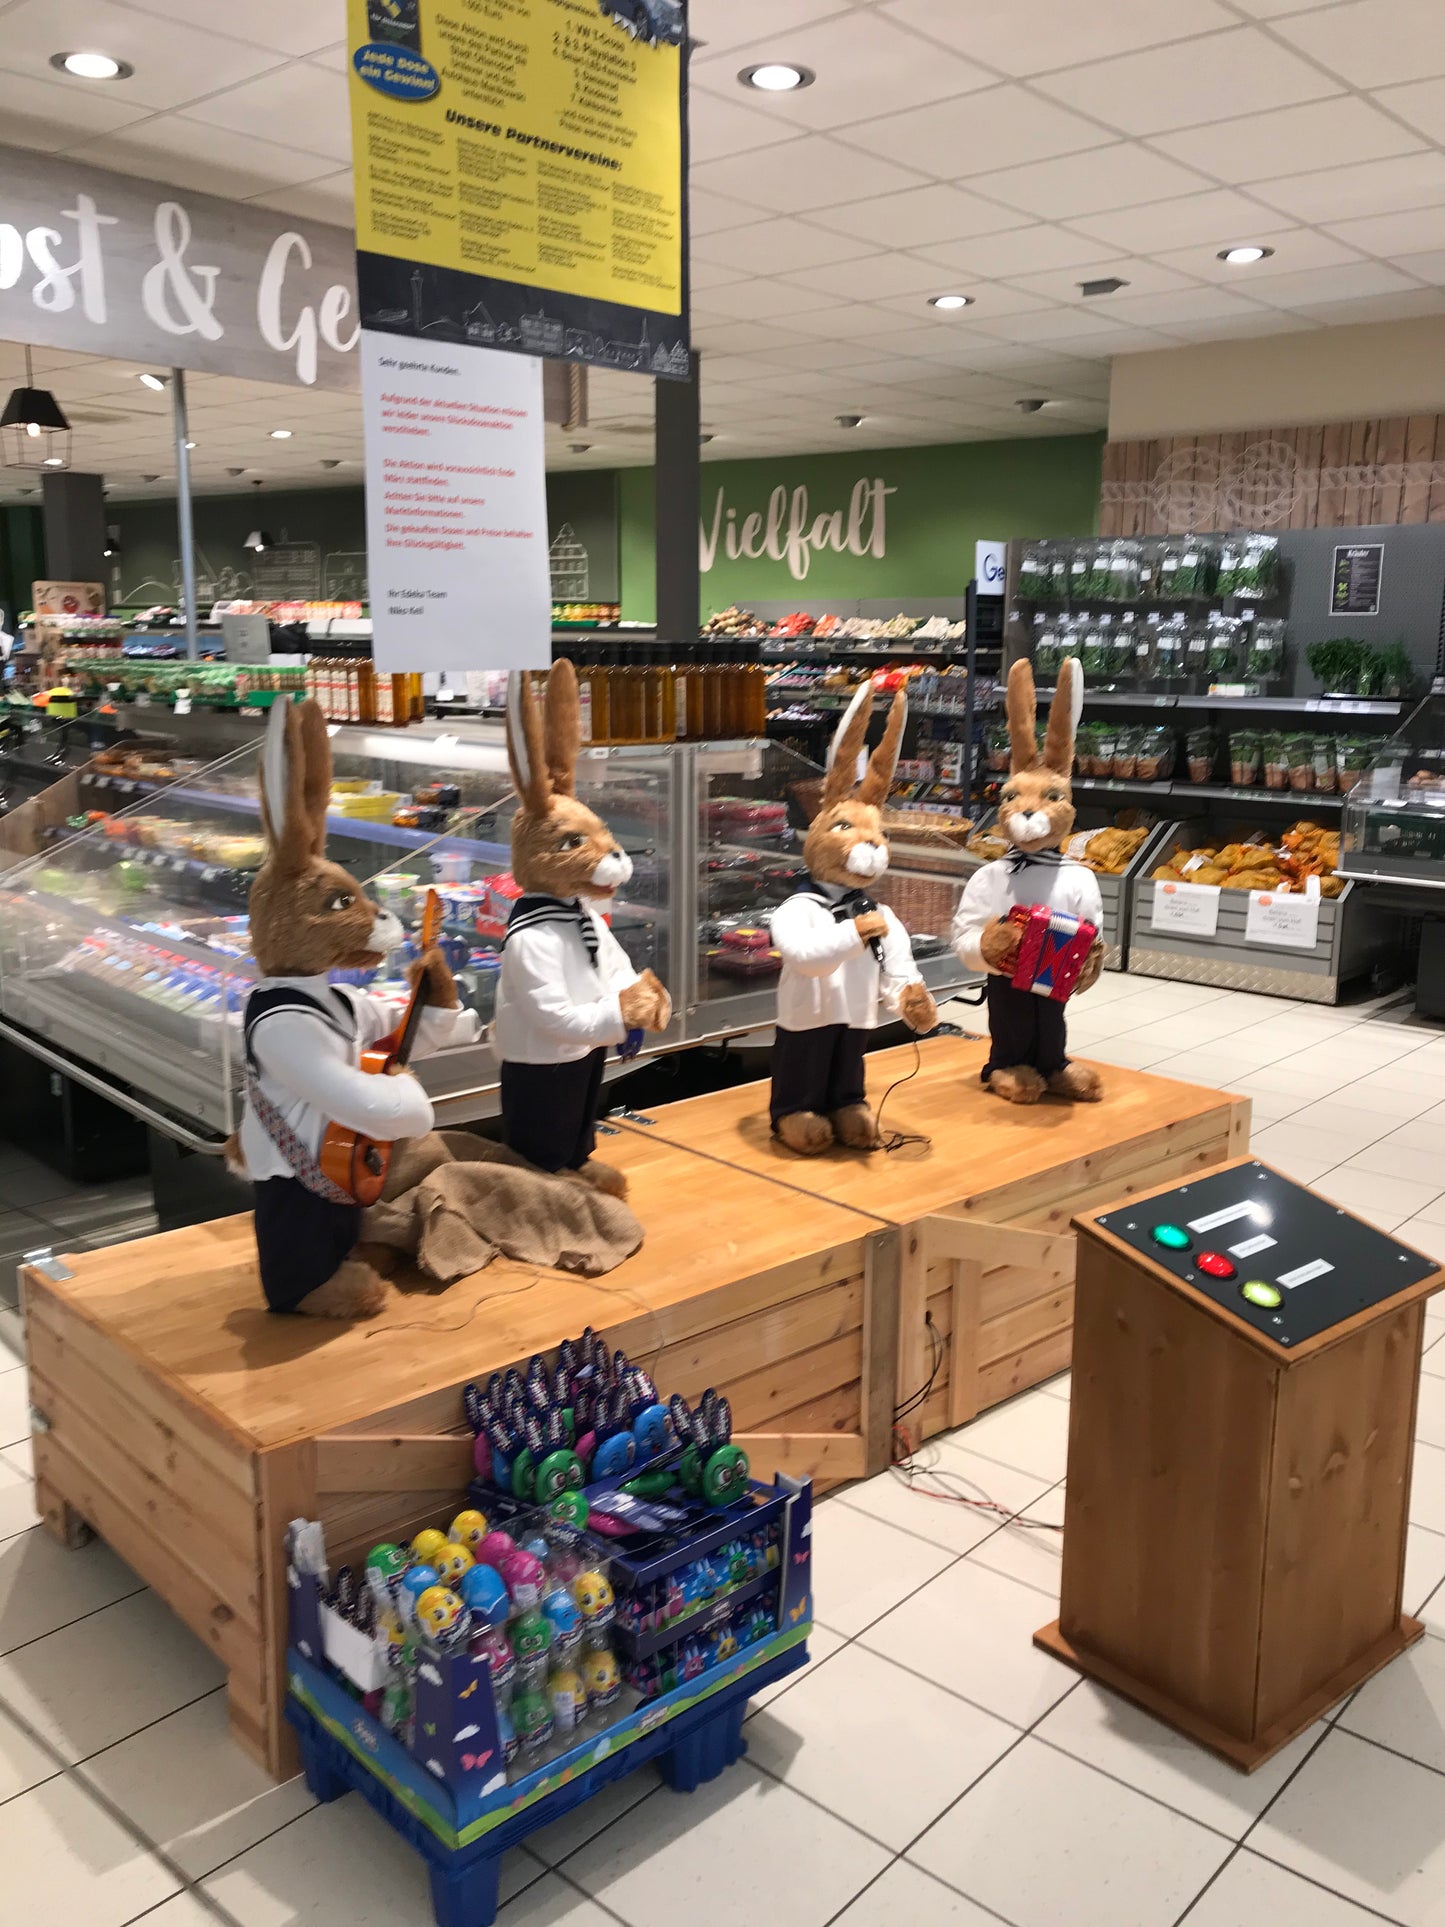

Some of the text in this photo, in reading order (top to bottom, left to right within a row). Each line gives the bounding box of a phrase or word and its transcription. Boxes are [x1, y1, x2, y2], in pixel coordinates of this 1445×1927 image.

[360, 65, 436, 91] ein Gewinn!
[363, 50, 430, 74] Jede Dose
[445, 109, 622, 171] Unsere Partnervereine:
[142, 202, 225, 341] &
[698, 477, 898, 581] Vielfalt
[983, 553, 1005, 582] Ge
